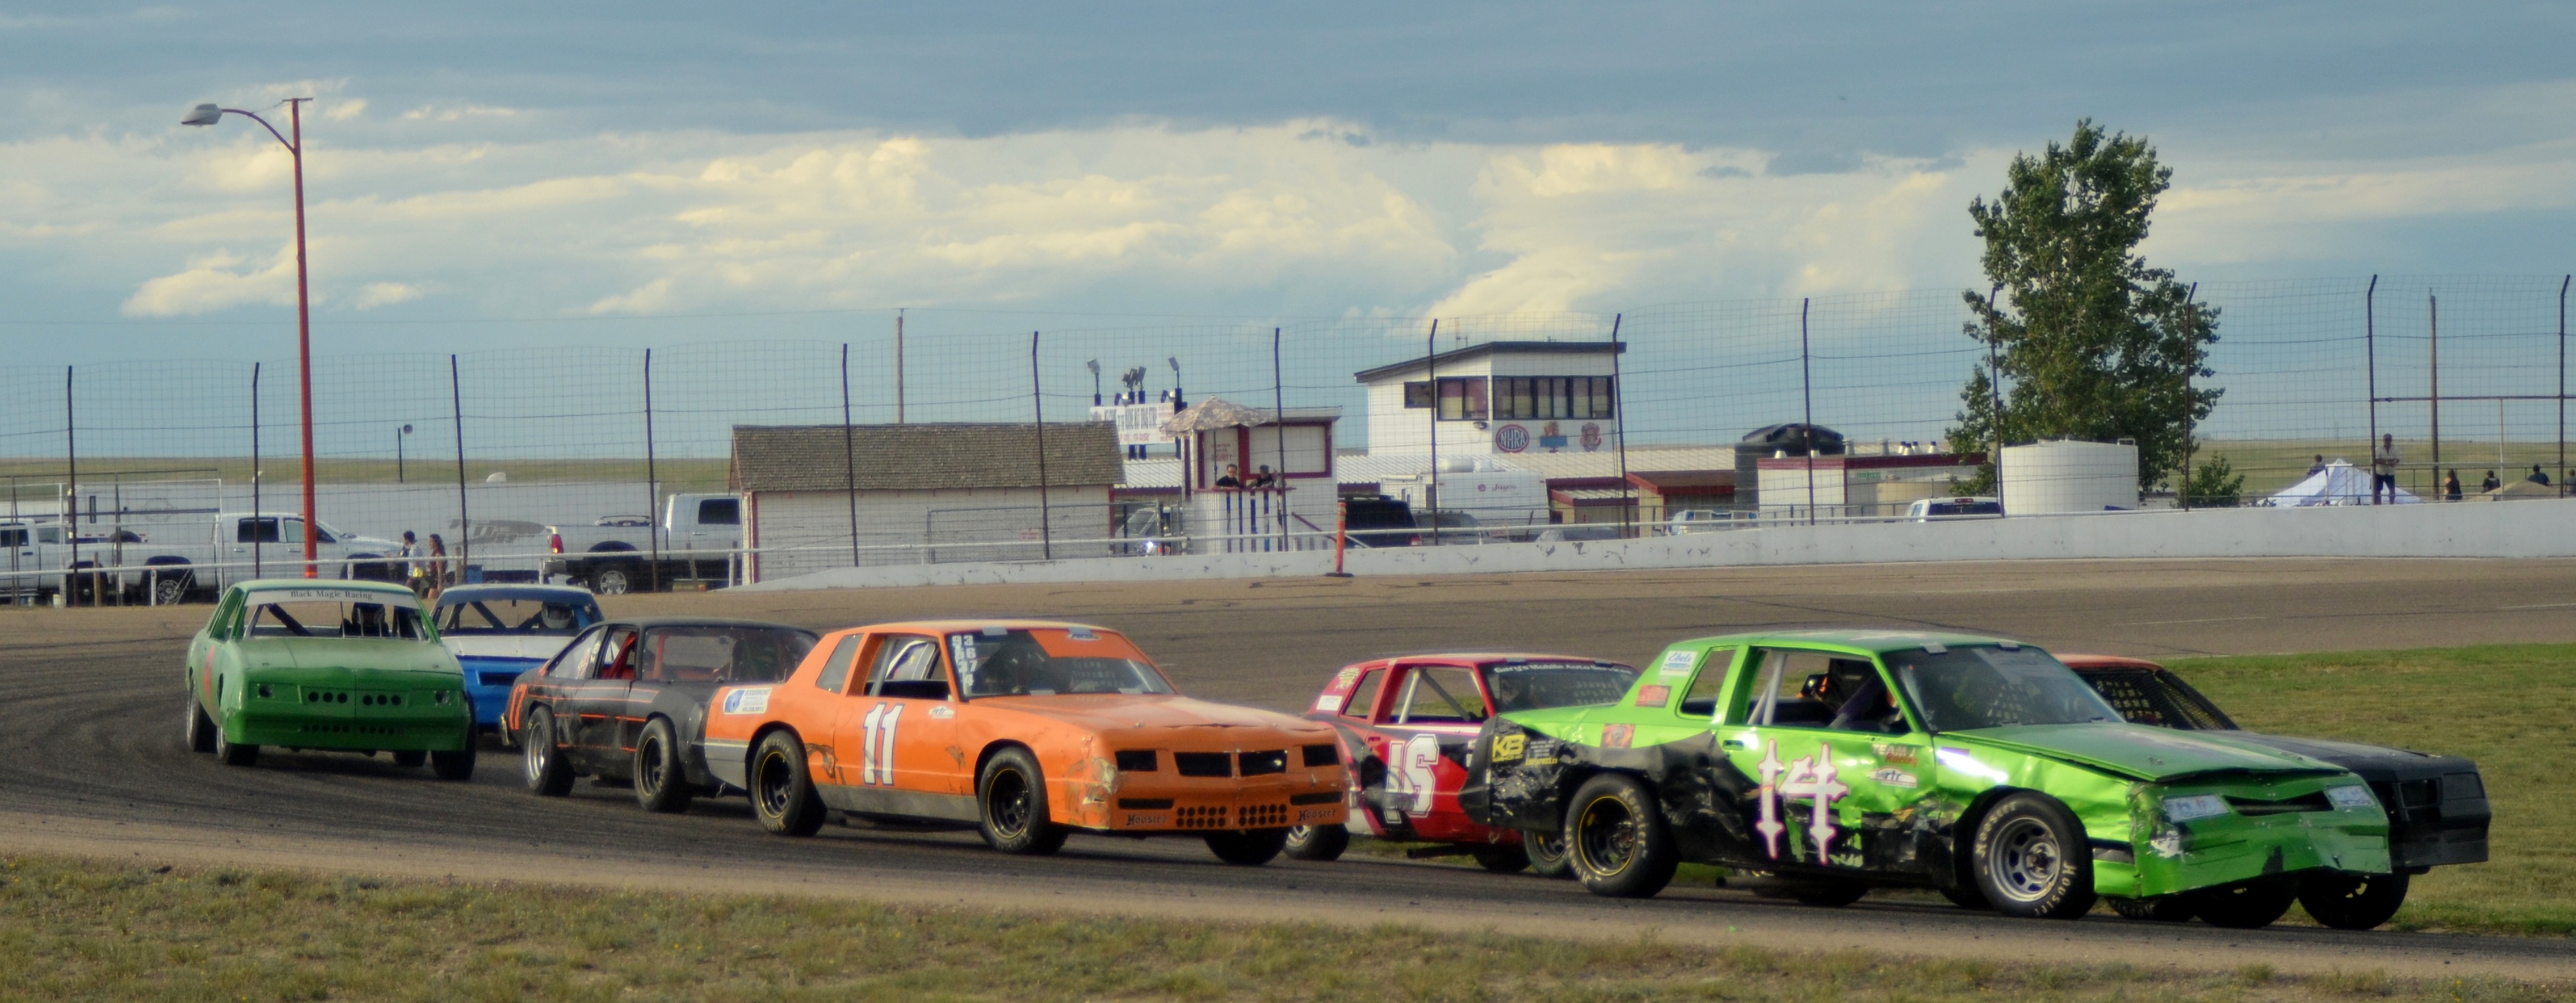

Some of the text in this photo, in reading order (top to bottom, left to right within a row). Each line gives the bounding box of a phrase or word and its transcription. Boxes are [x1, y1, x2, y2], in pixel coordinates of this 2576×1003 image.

[1499, 427, 1526, 448] NHRA
[316, 590, 341, 599] Magic
[345, 591, 373, 600] Racing
[1493, 665, 1529, 673] Gary's
[863, 702, 905, 786] 11
[1492, 733, 1526, 758] KB
[1872, 743, 1907, 756] TEAM
[1885, 752, 1918, 768] Racing
[1755, 738, 1850, 866] 14
